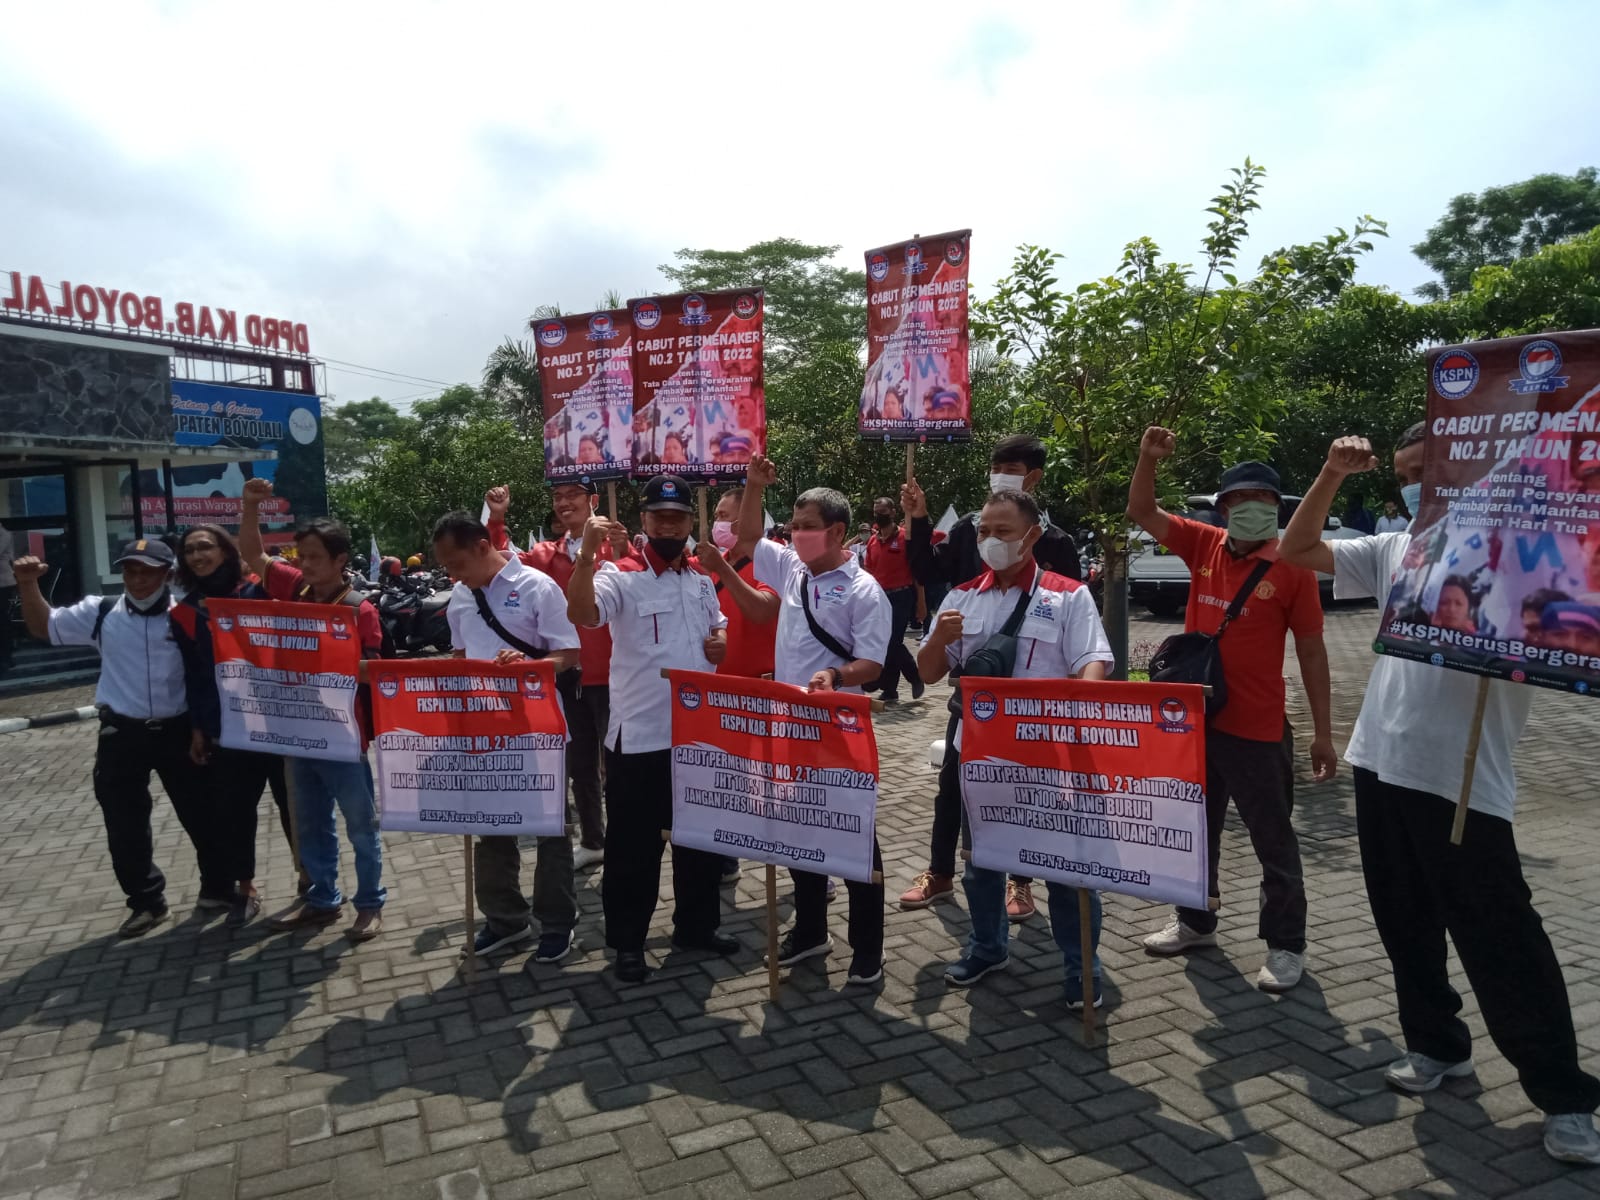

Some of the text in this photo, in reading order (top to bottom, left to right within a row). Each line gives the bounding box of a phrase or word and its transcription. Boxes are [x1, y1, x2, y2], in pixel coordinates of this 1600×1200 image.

[871, 279, 966, 305] CABUT PERMENAKER
[637, 310, 658, 320] KSPN
[881, 305, 898, 319] NO.2
[938, 297, 959, 311] 2022
[636, 331, 760, 352] CABUT PERMENAKER
[542, 352, 583, 368] CABUT
[649, 348, 753, 366] NO.2 TAHUN 2022
[557, 360, 629, 379] NO.2 TAHUN
[1440, 368, 1473, 382] KSPN
[642, 381, 660, 389] Tata
[682, 378, 698, 386] dan
[223, 418, 283, 440] BOYOLALI
[863, 418, 965, 430] #KSPNterusBergerak
[1432, 411, 1600, 436] CABUT PERMEN
[1449, 440, 1488, 460] NO.2
[1494, 438, 1571, 460] TAHUN
[638, 462, 749, 474] #KSPNterusBerger
[1488, 472, 1547, 488] tentang
[1434, 486, 1459, 497] Tata
[1462, 487, 1488, 497] Cara
[1491, 486, 1515, 498] dan
[204, 500, 237, 513] Warga
[1447, 501, 1524, 514] Pembayaran
[1453, 514, 1588, 534] Jaminan Hari Tua
[282, 636, 318, 650] BOYOLALI
[332, 675, 356, 689] 2022
[405, 677, 518, 692] DEWAN PENGURUS DAERAH
[417, 697, 512, 712] FKSPN KAB. BOYOLALI
[681, 692, 699, 700] KSPN
[707, 692, 831, 723] DEWAN PENGURUS DAERAH
[974, 701, 995, 711] KSPN
[1004, 698, 1153, 723] DEWAN PENGURUS DAERAH
[721, 714, 820, 741] FKSPN KAB. BOYOLALI
[1015, 722, 1139, 747] FKSPN KAB. BOYOLALI
[380, 735, 408, 750] CABUT
[475, 736, 492, 751] NO.
[495, 736, 501, 749] 2
[504, 735, 536, 750] Tahun
[537, 734, 563, 750] 2022
[417, 754, 523, 771] JHT 100% UANG BURUH
[675, 747, 875, 790] CABUT PERMENNAKER NO. 2 Tahun 2022
[391, 773, 555, 791] JANGAN PERSULIT AMBIL UANG KAMI
[715, 772, 826, 806] JHT 100% UANG BURUH
[965, 763, 1203, 803] CABUT PERMENNAKER NO. 2 Tahun 2022
[685, 787, 861, 833] JANGAN PERSULIT AMBIL UANG KAMI
[1015, 787, 1153, 820] JHT 100% UANG BURUH
[420, 809, 522, 826] #KSPN Terus Bergerak
[981, 805, 1192, 852] JANGAN PERSULIT AMBIL UANG KAMI
[714, 829, 825, 862] #KSPN Terus Bergerak
[1019, 849, 1150, 885] #KSPN Terus Bergerak
